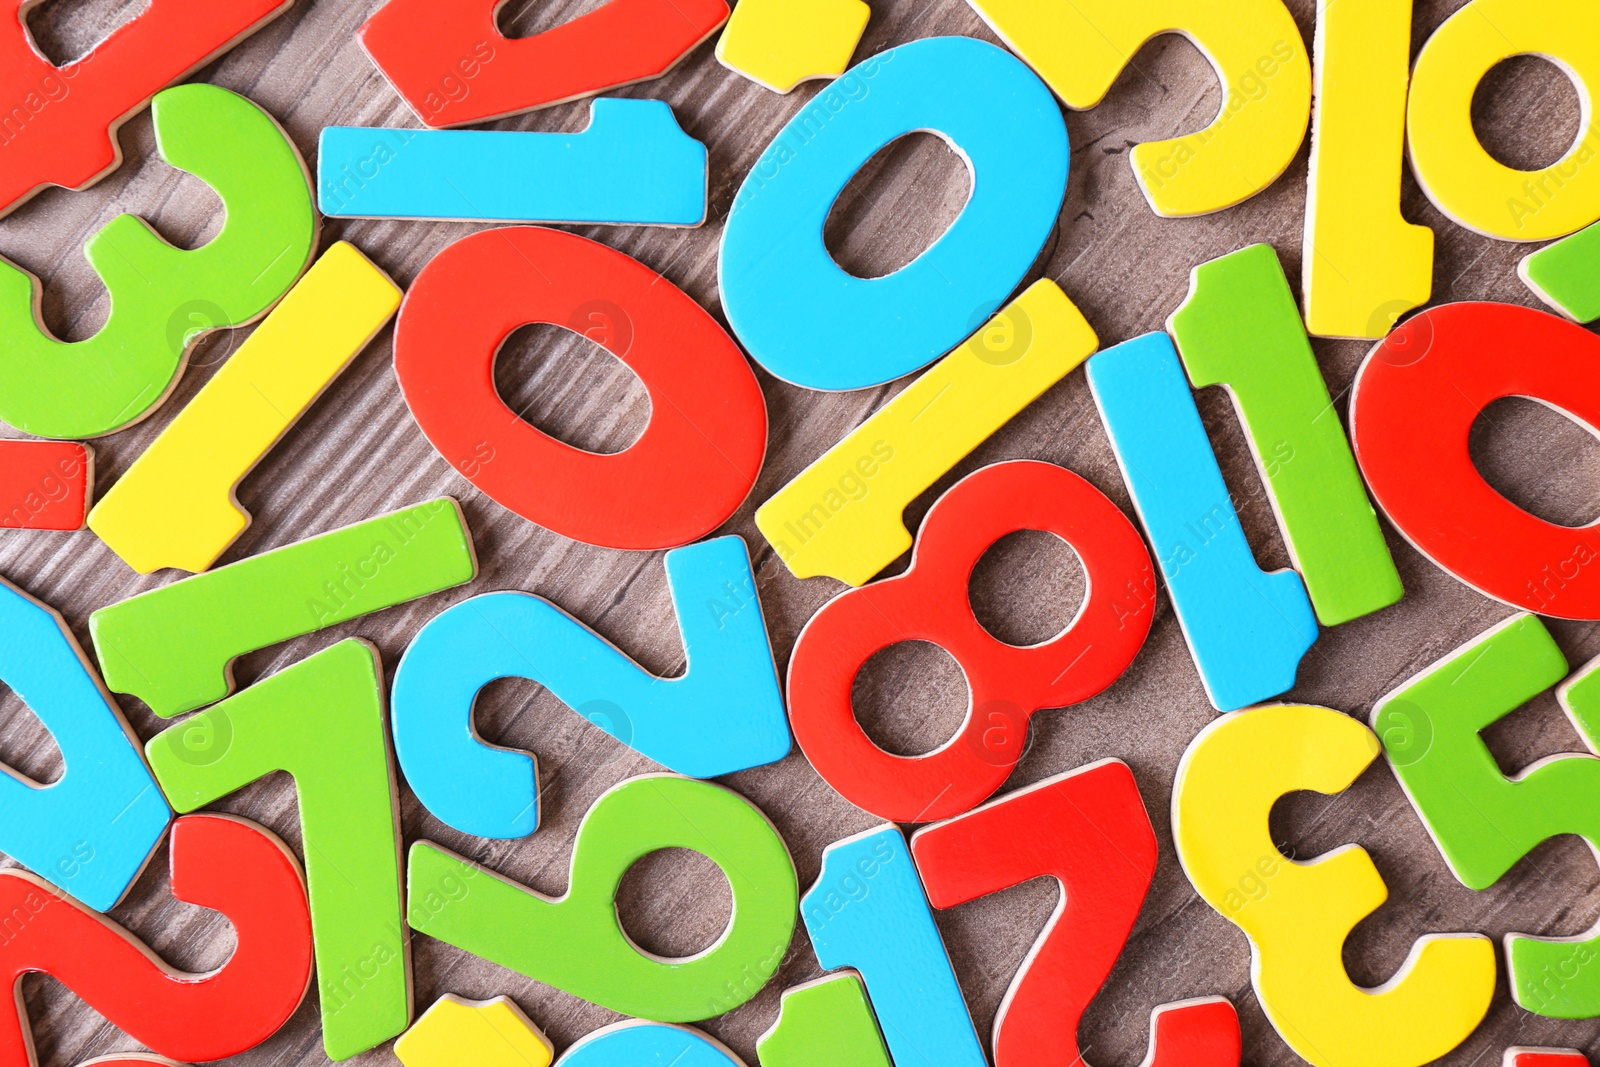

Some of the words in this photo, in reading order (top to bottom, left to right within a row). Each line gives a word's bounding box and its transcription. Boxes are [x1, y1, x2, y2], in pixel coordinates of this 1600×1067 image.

[393, 225, 768, 551] 0
[718, 36, 1071, 392] 0
[786, 459, 1158, 824] 8
